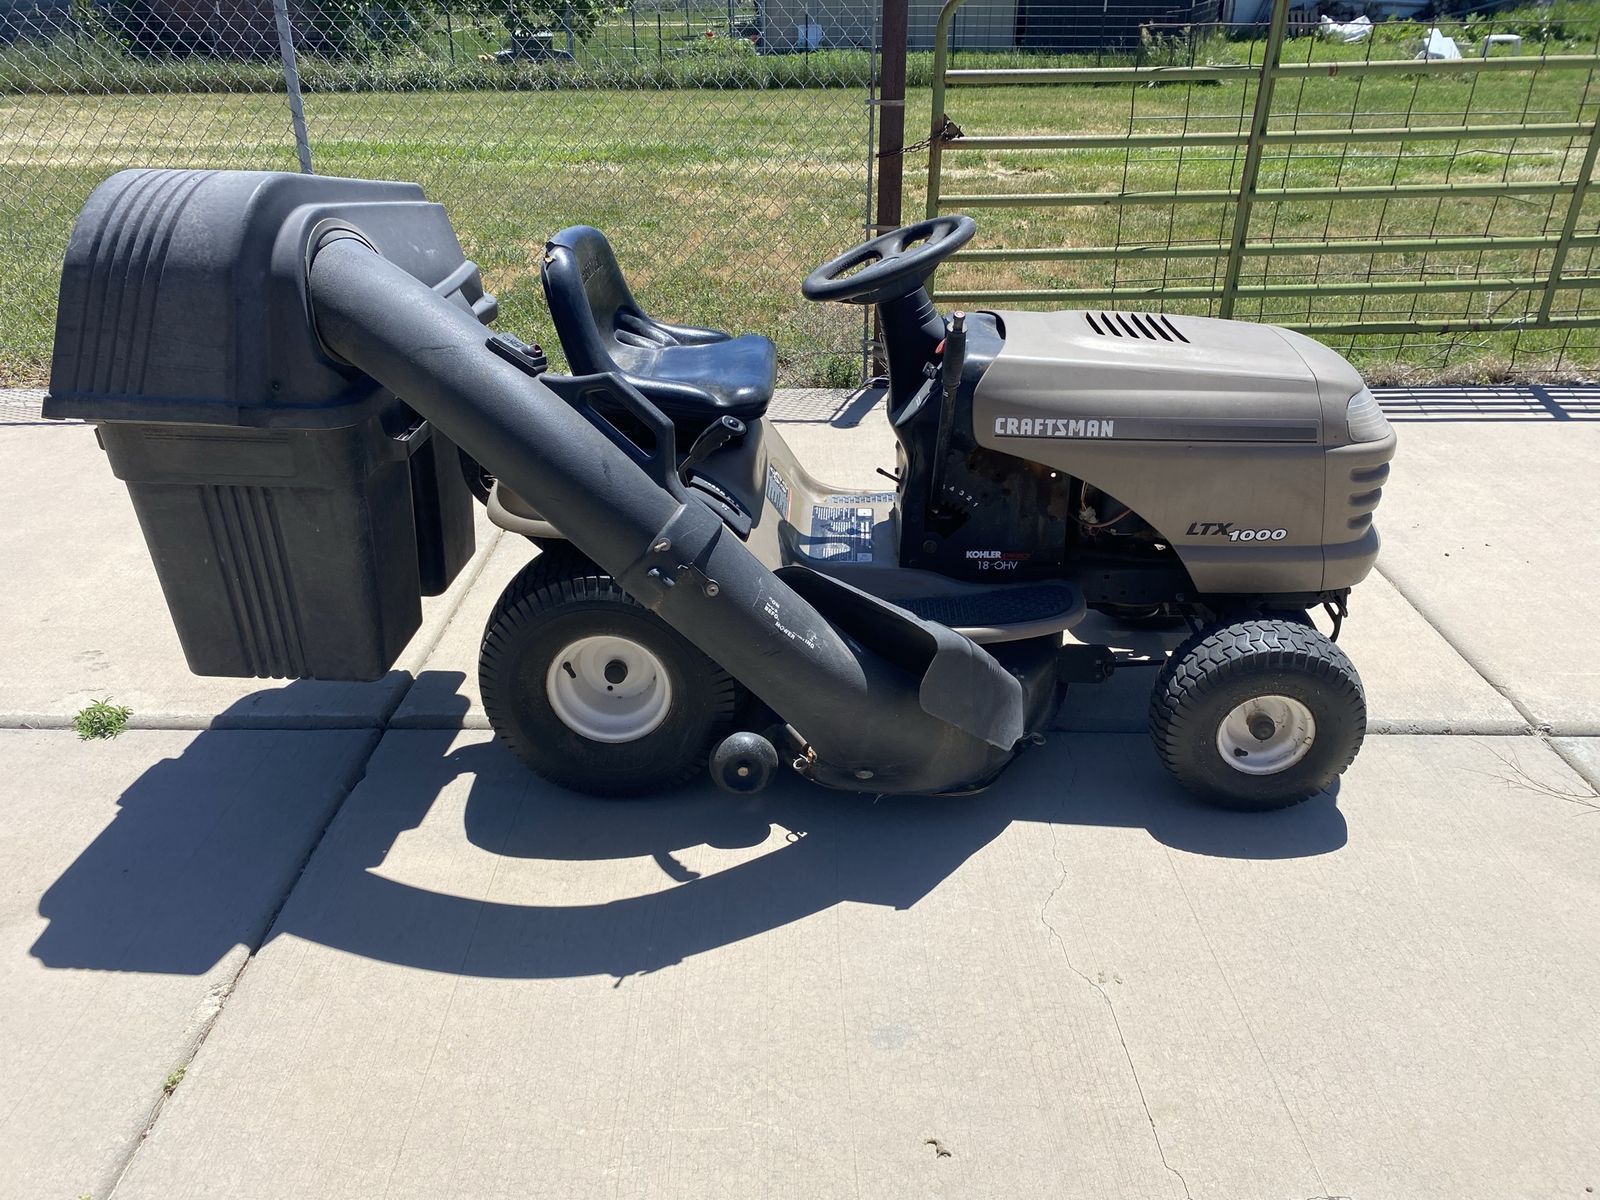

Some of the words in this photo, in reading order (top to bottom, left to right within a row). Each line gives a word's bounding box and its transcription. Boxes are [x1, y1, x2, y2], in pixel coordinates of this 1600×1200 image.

[995, 417, 1115, 437] CRAFTSMAN
[1186, 521, 1234, 536] LTX
[1227, 528, 1288, 542] 1000
[966, 550, 1002, 559] KOHLER
[978, 560, 990, 570] 18
[775, 621, 796, 640] MOWER
